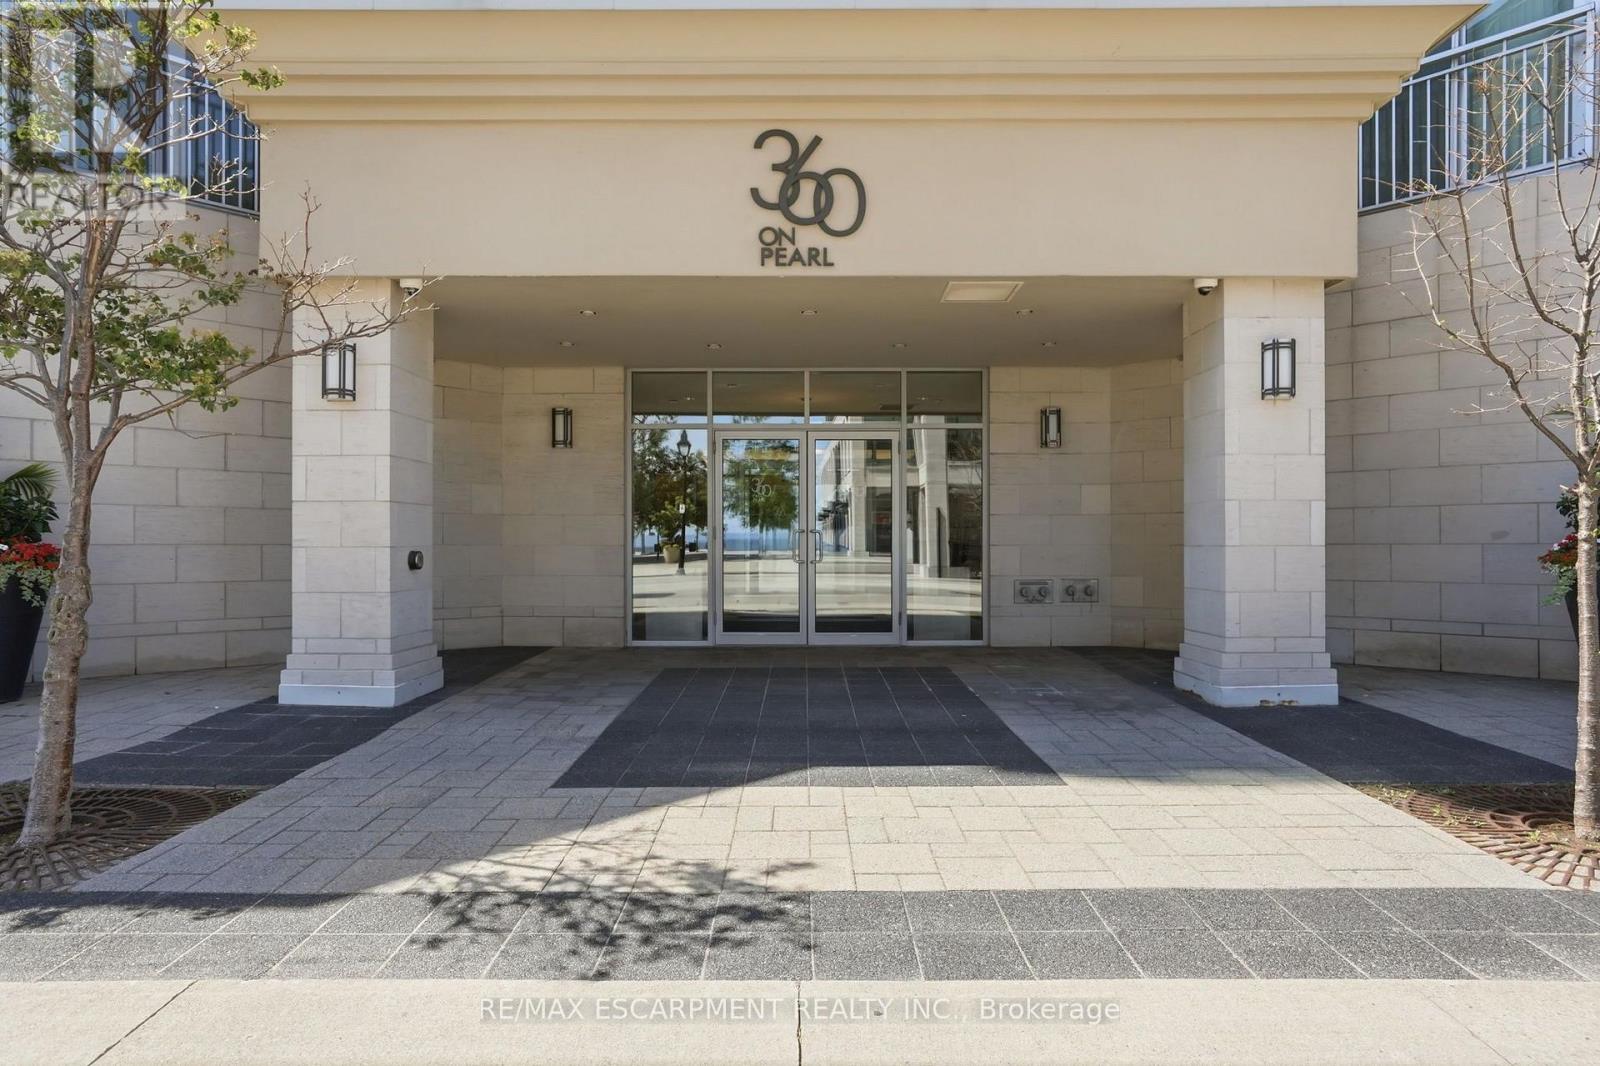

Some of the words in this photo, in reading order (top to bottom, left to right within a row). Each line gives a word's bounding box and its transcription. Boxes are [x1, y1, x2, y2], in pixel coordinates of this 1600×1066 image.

[750, 129, 866, 237] 360
[759, 226, 796, 246] ON
[760, 247, 834, 267] PEARL
